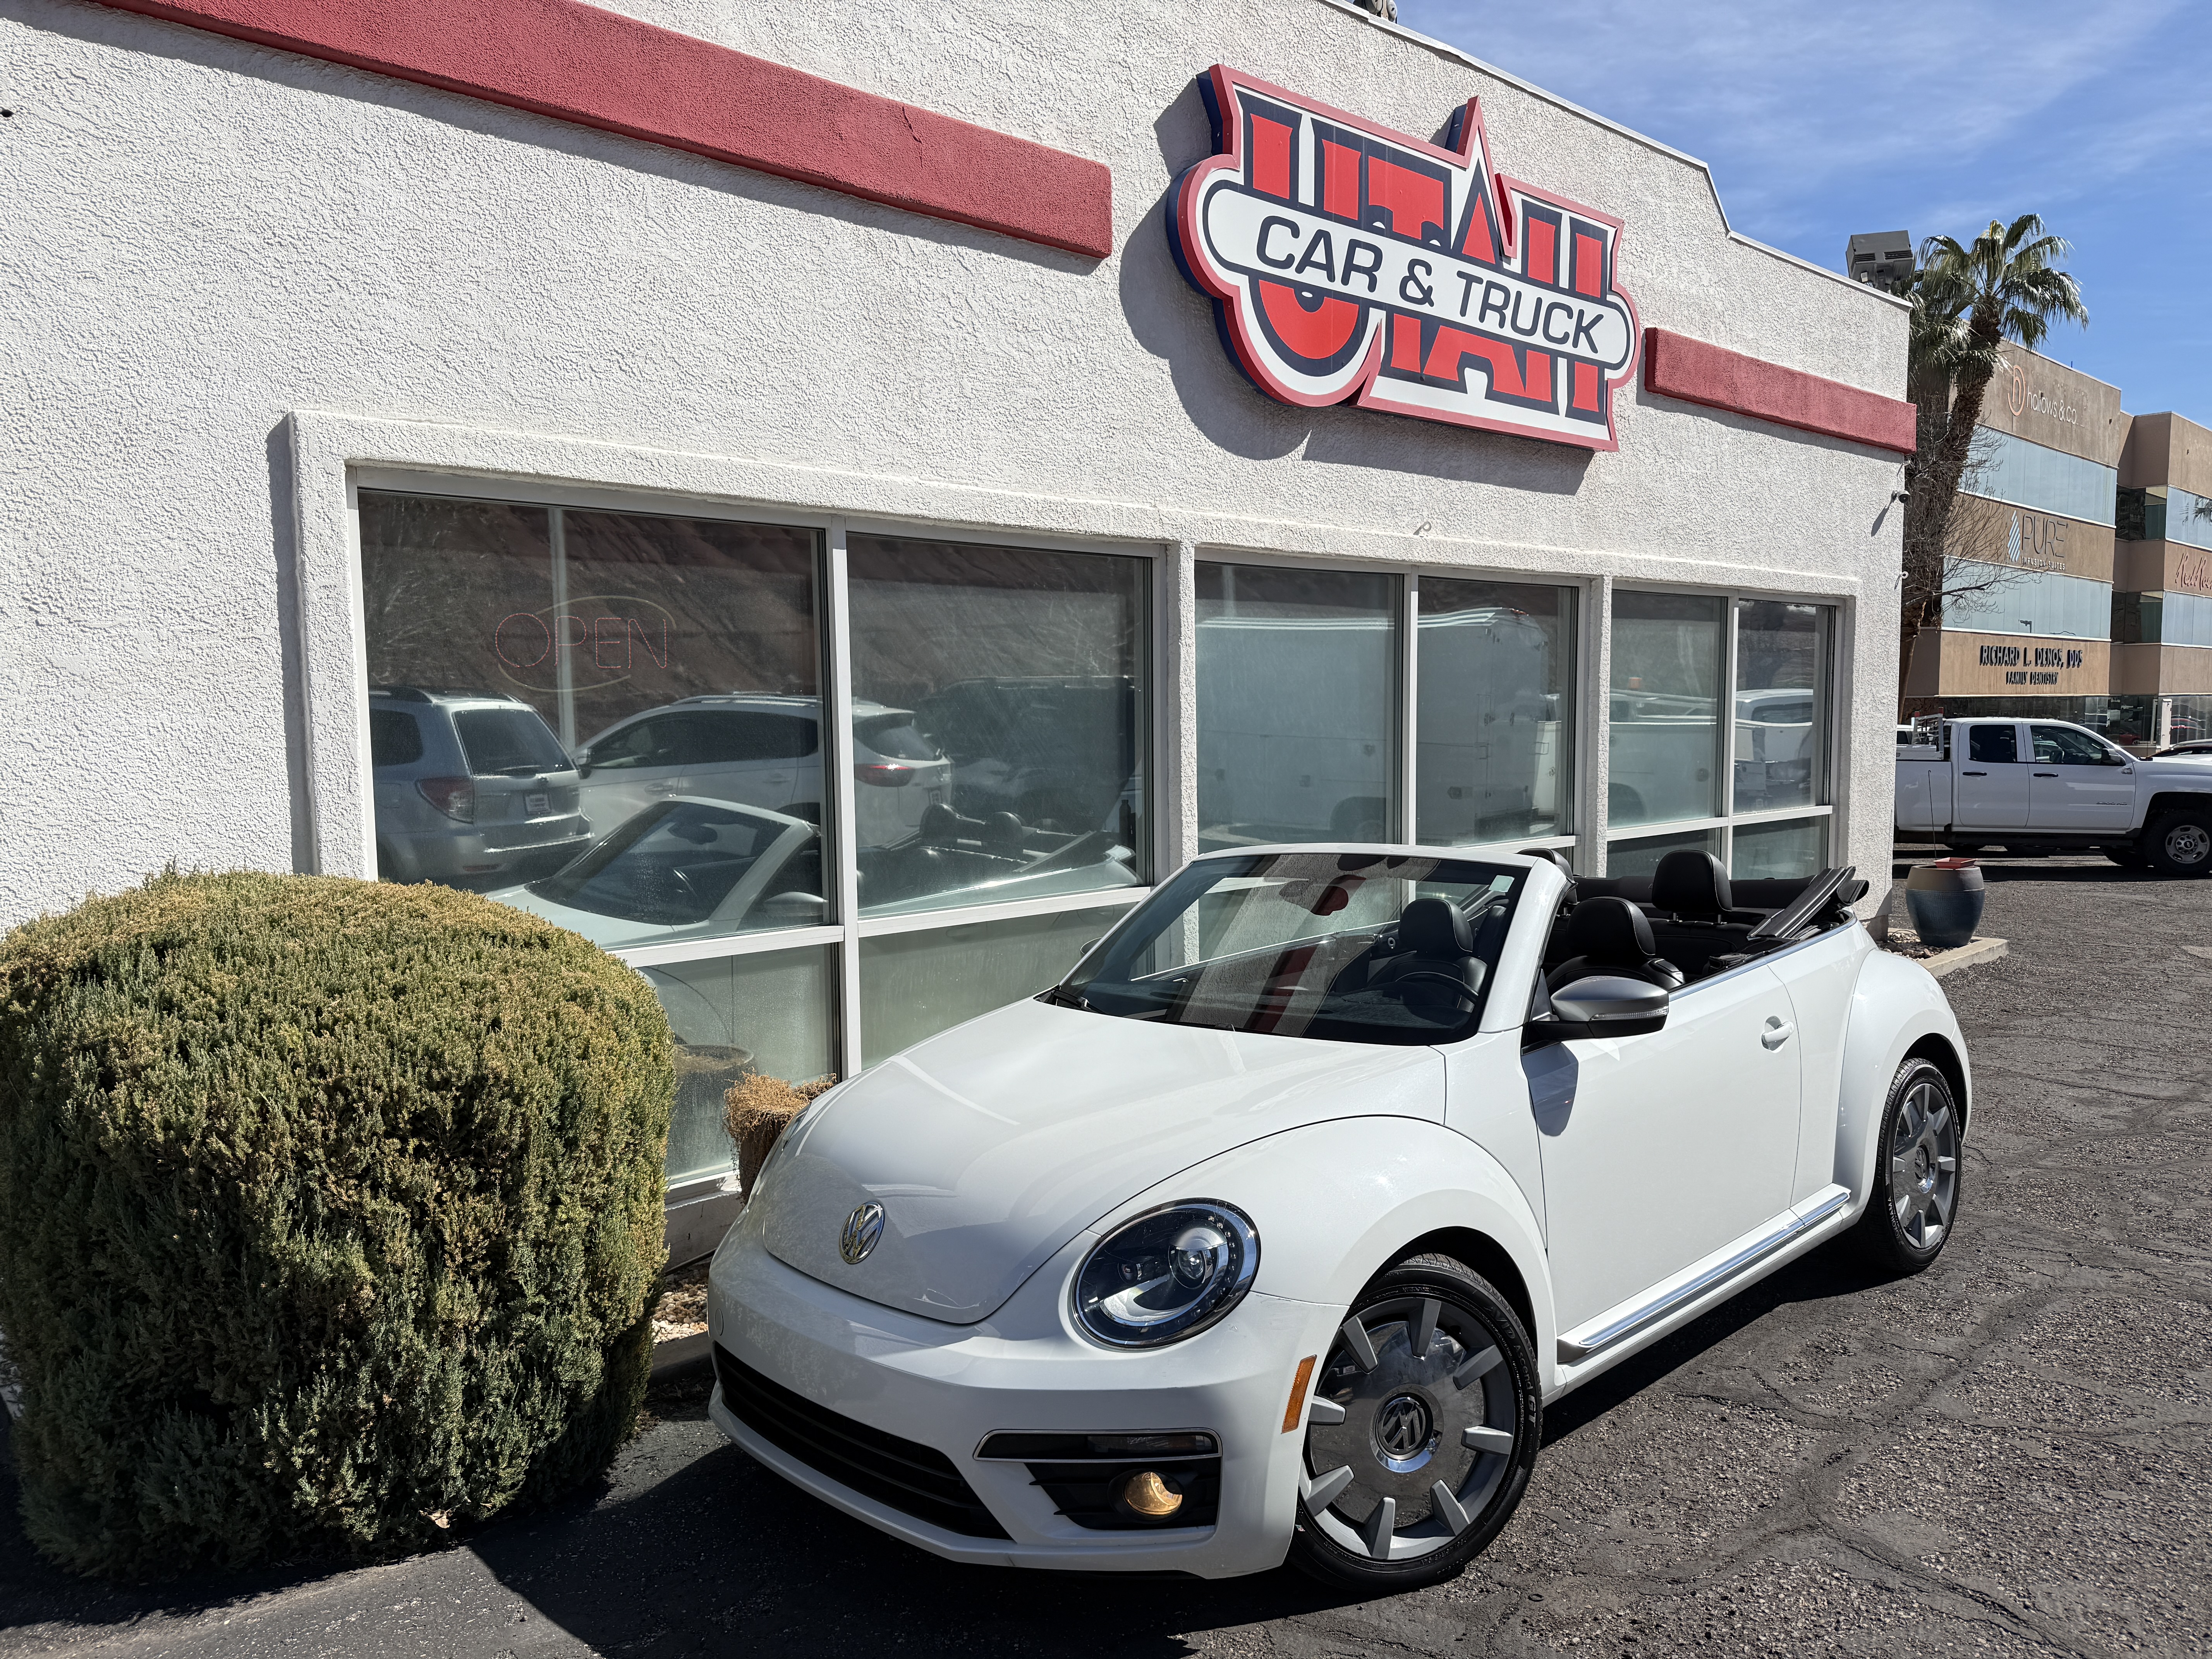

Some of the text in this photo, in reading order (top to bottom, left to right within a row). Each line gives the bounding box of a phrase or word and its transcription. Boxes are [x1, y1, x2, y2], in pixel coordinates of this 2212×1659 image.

[1256, 215, 1604, 354] CAR & TRUCK
[2027, 386, 2057, 418] hallows
[2022, 514, 2067, 558] PURE
[2048, 560, 2066, 570] SUITES
[495, 612, 667, 668] OPEN
[1980, 645, 2083, 670] RICHARD L. DENOS, DDS
[2006, 671, 2059, 685] FAMILY DENTISTRY
[1513, 1344, 1534, 1390] Ascend
[1528, 1394, 1536, 1428] GT
